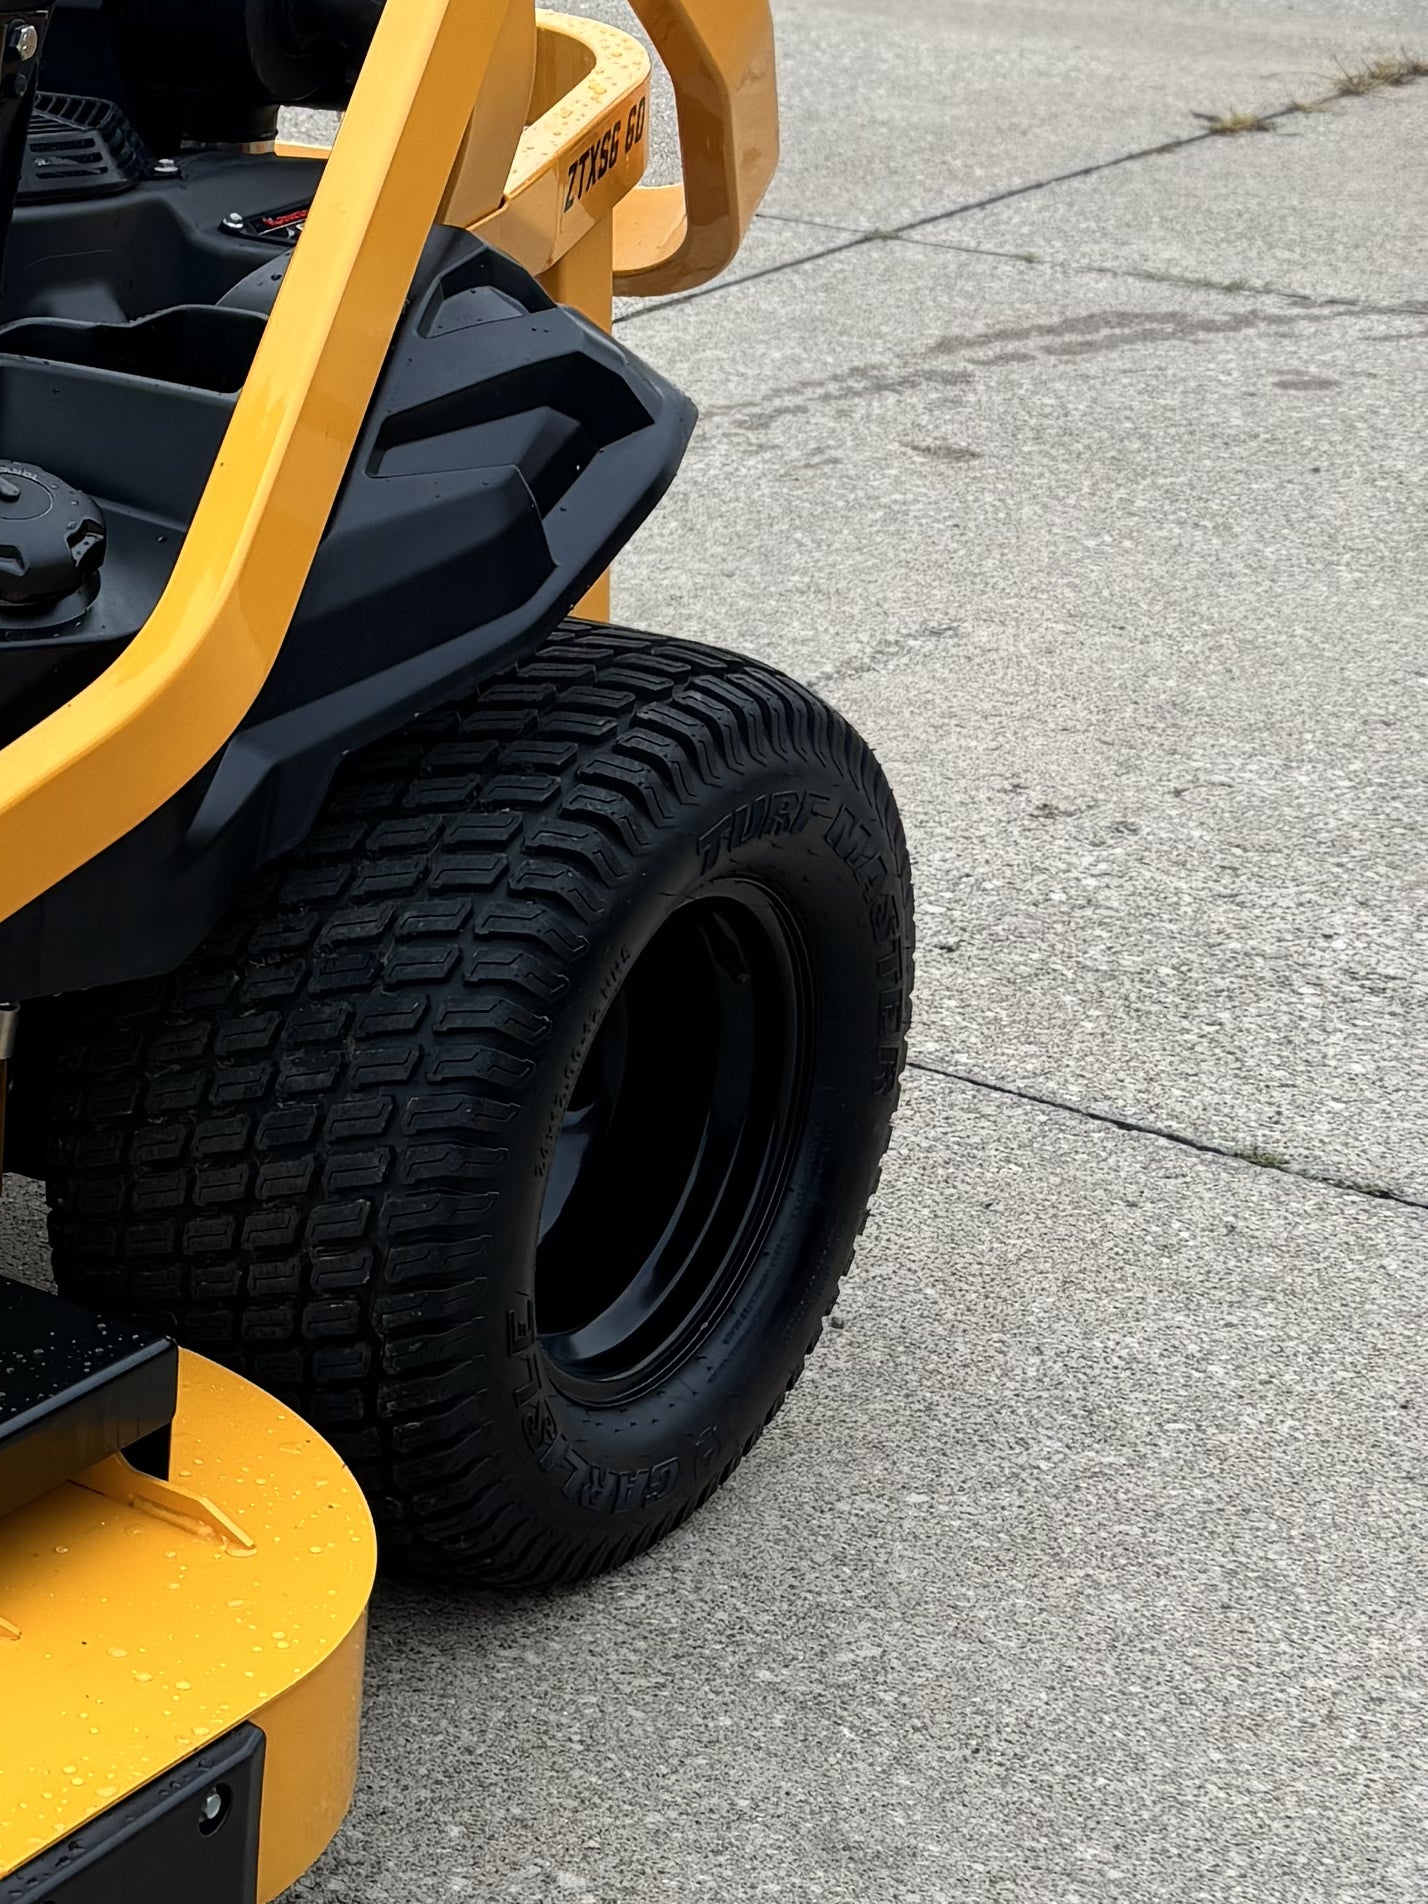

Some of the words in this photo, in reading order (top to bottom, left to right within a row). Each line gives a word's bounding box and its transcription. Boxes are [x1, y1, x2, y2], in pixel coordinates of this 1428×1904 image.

[564, 119, 622, 213] ZTXS6
[624, 96, 646, 154] 60
[695, 789, 833, 876] TURF
[824, 802, 903, 1098] MASTER
[505, 1299, 681, 1515] CARLISLE
